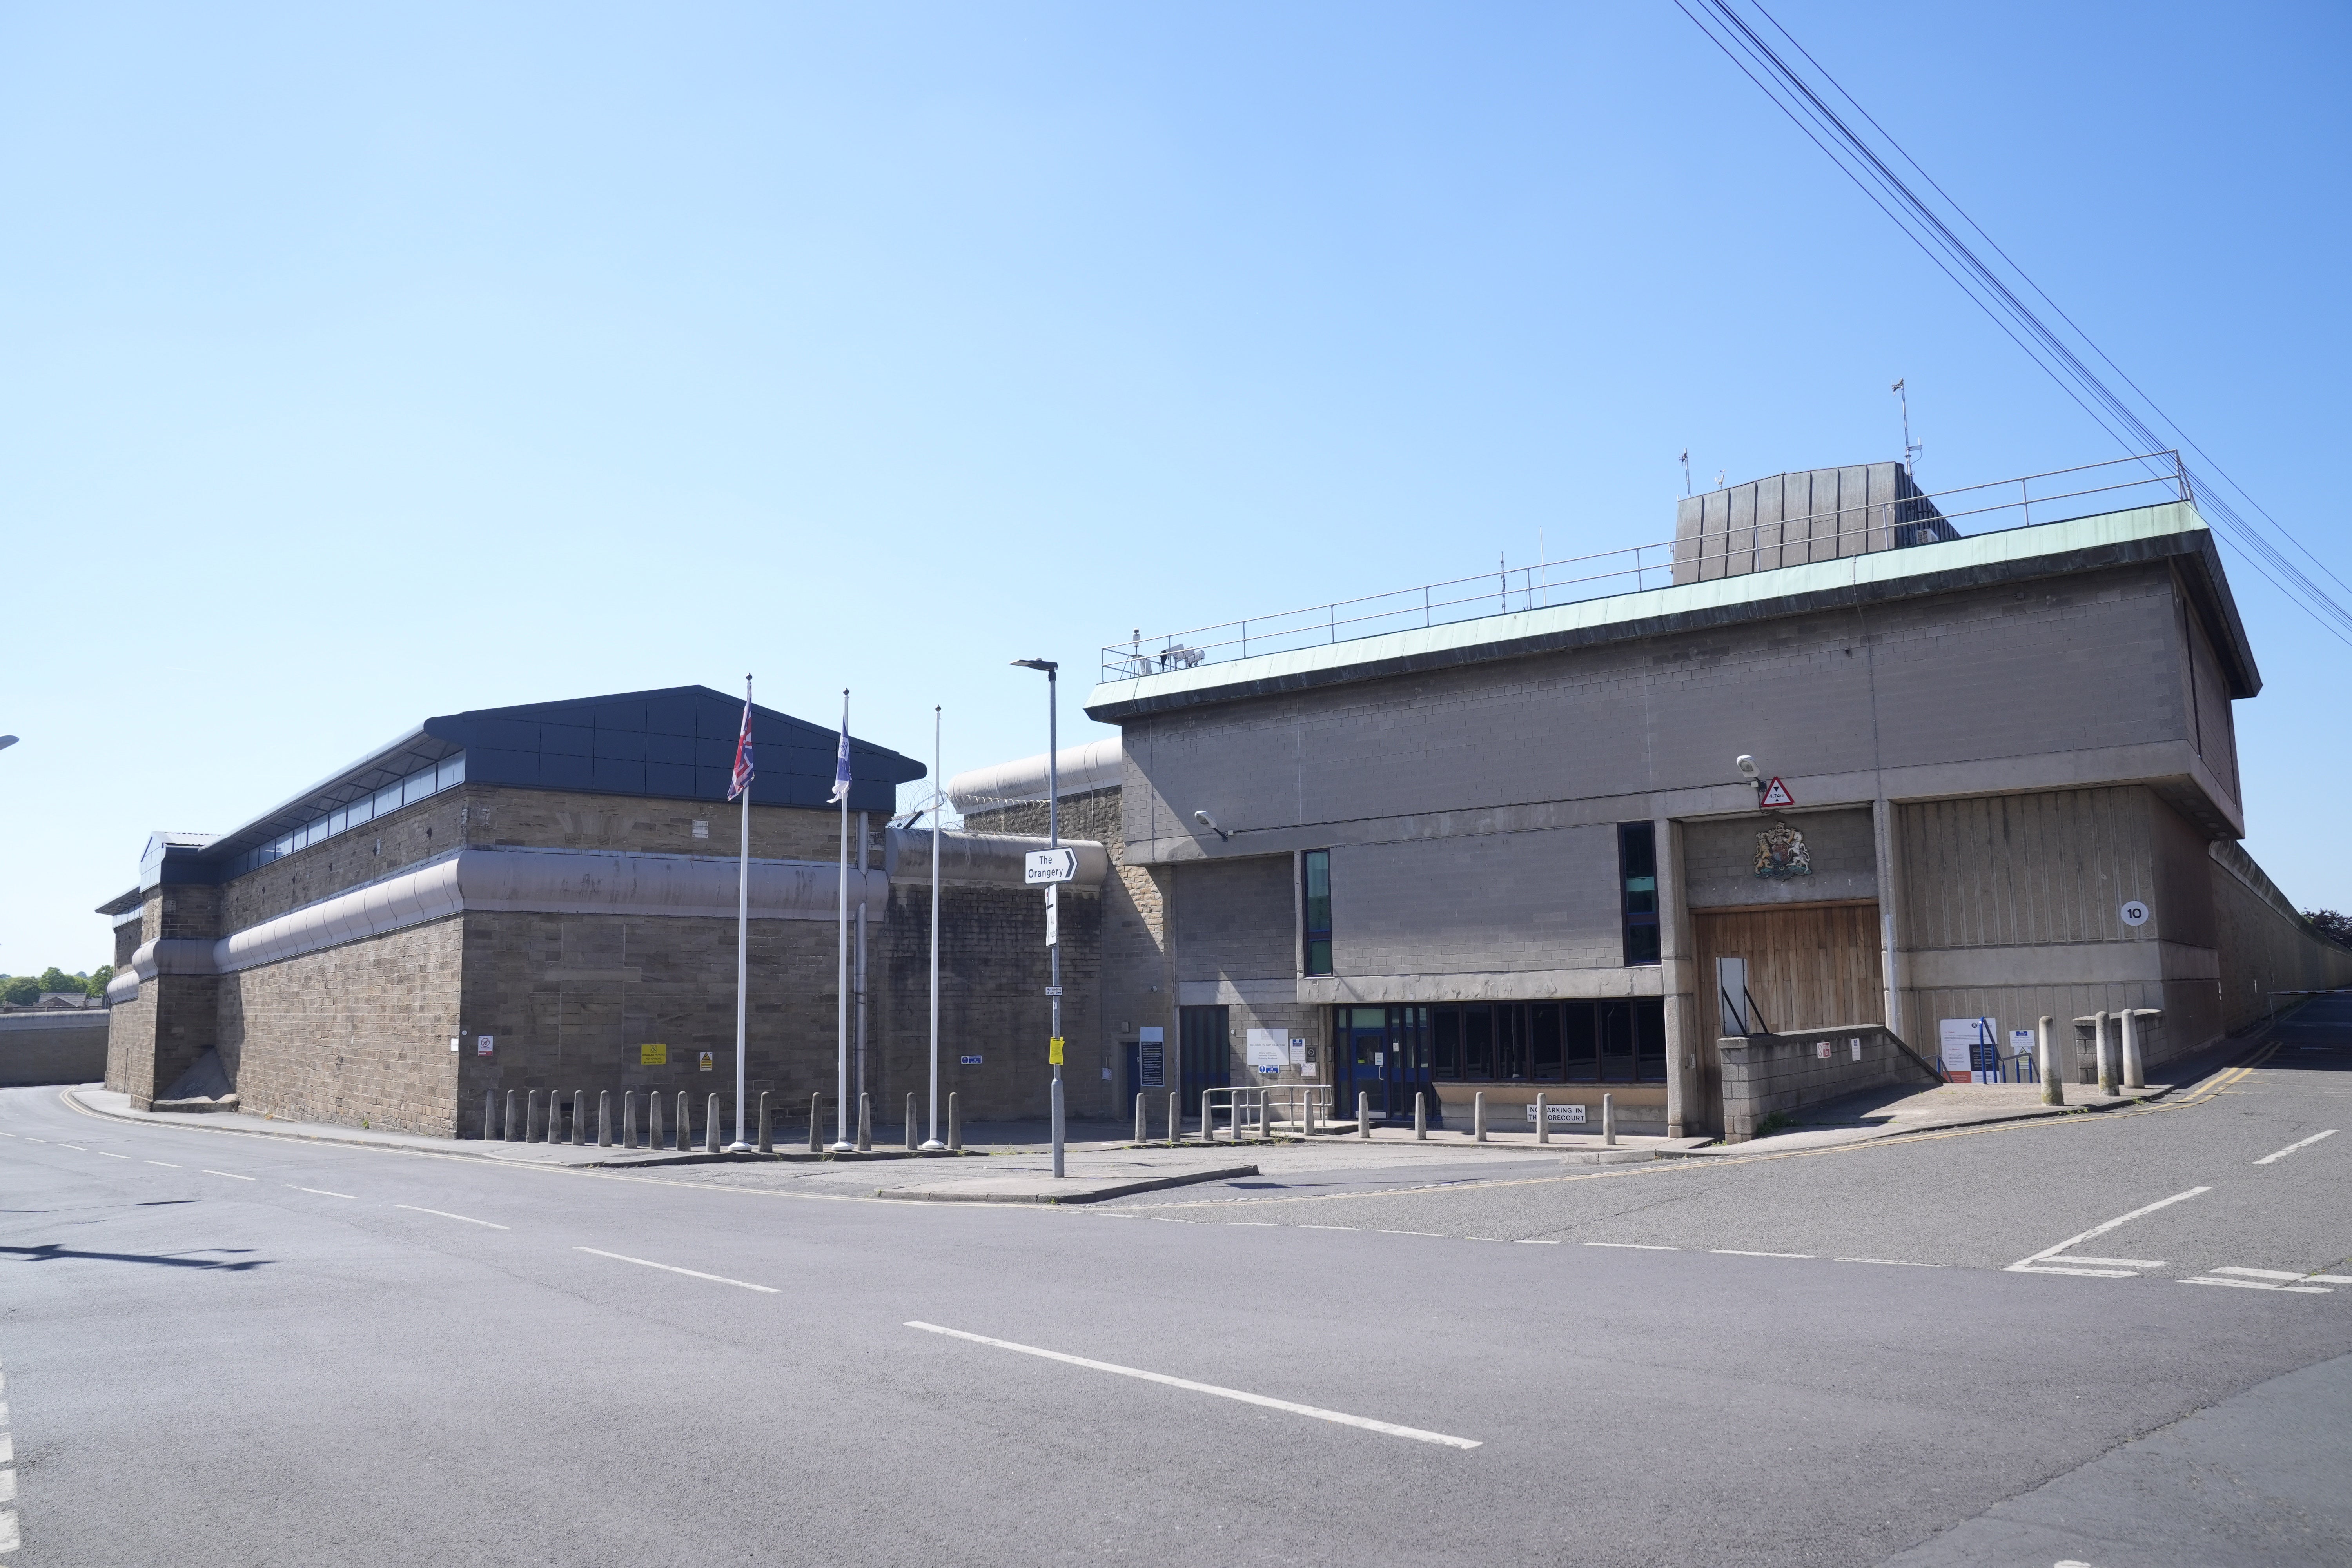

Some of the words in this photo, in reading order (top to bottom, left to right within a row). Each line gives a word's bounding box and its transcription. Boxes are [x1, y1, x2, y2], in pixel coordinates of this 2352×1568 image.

[1039, 855, 1052, 865] The
[1028, 868, 1063, 878] Orangery
[2127, 908, 2142, 918] 10
